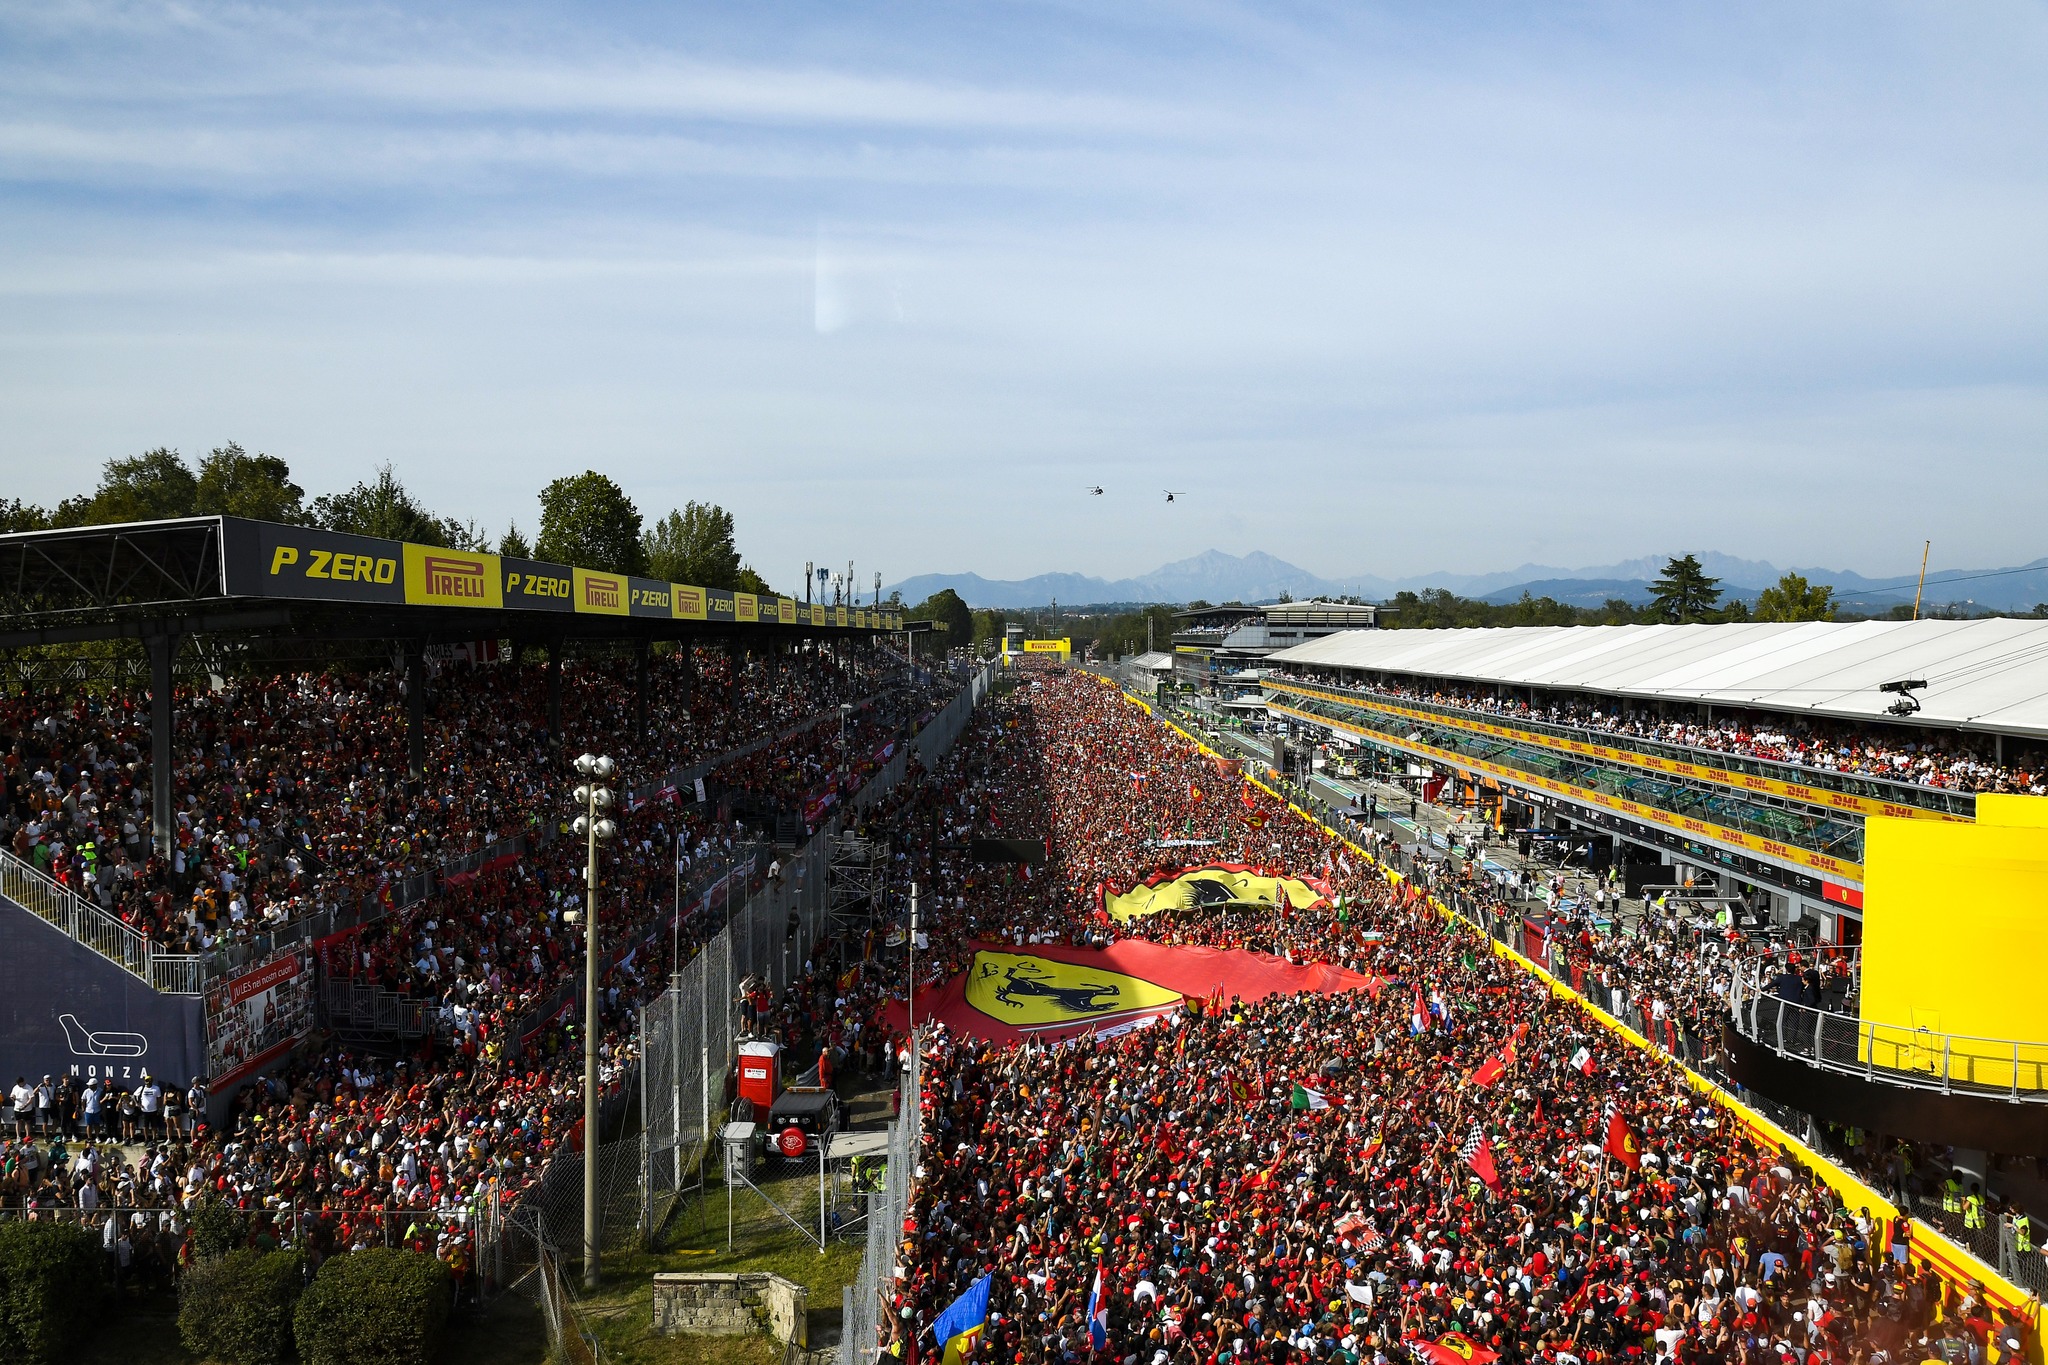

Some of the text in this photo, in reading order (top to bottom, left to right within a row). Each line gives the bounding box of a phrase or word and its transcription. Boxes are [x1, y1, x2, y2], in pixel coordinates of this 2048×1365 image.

[270, 546, 397, 584] P ZERO
[425, 556, 484, 598] PIRELLI
[506, 572, 570, 598] P ZERO
[585, 577, 618, 608] PIRELLI
[632, 589, 668, 607] P ZERO
[678, 591, 700, 613] PIRELLI
[715, 599, 733, 612] ZERO
[1570, 743, 1584, 751] DHL
[1593, 747, 1608, 757] DHL
[1618, 752, 1634, 762] DHL
[1646, 758, 1662, 768] DHL
[1676, 763, 1695, 775] DHL
[1709, 770, 1730, 783] DHL
[1547, 781, 1560, 791] DHL
[1745, 777, 1768, 790] DHL
[1570, 787, 1584, 798] DHL
[1786, 786, 1812, 799] DHL
[1594, 794, 1610, 805] DHL
[1832, 794, 1861, 809] DHL
[1622, 802, 1639, 813] DHL
[1883, 805, 1916, 818] DHL
[1652, 810, 1670, 823] DHL
[1685, 819, 1706, 834] DHL
[1722, 830, 1744, 844] DHL
[1763, 841, 1790, 857] DHL
[1810, 854, 1840, 872] DHL
[234, 962, 292, 1000] JULES nei nostri cuori
[71, 1065, 148, 1079] MONZA
